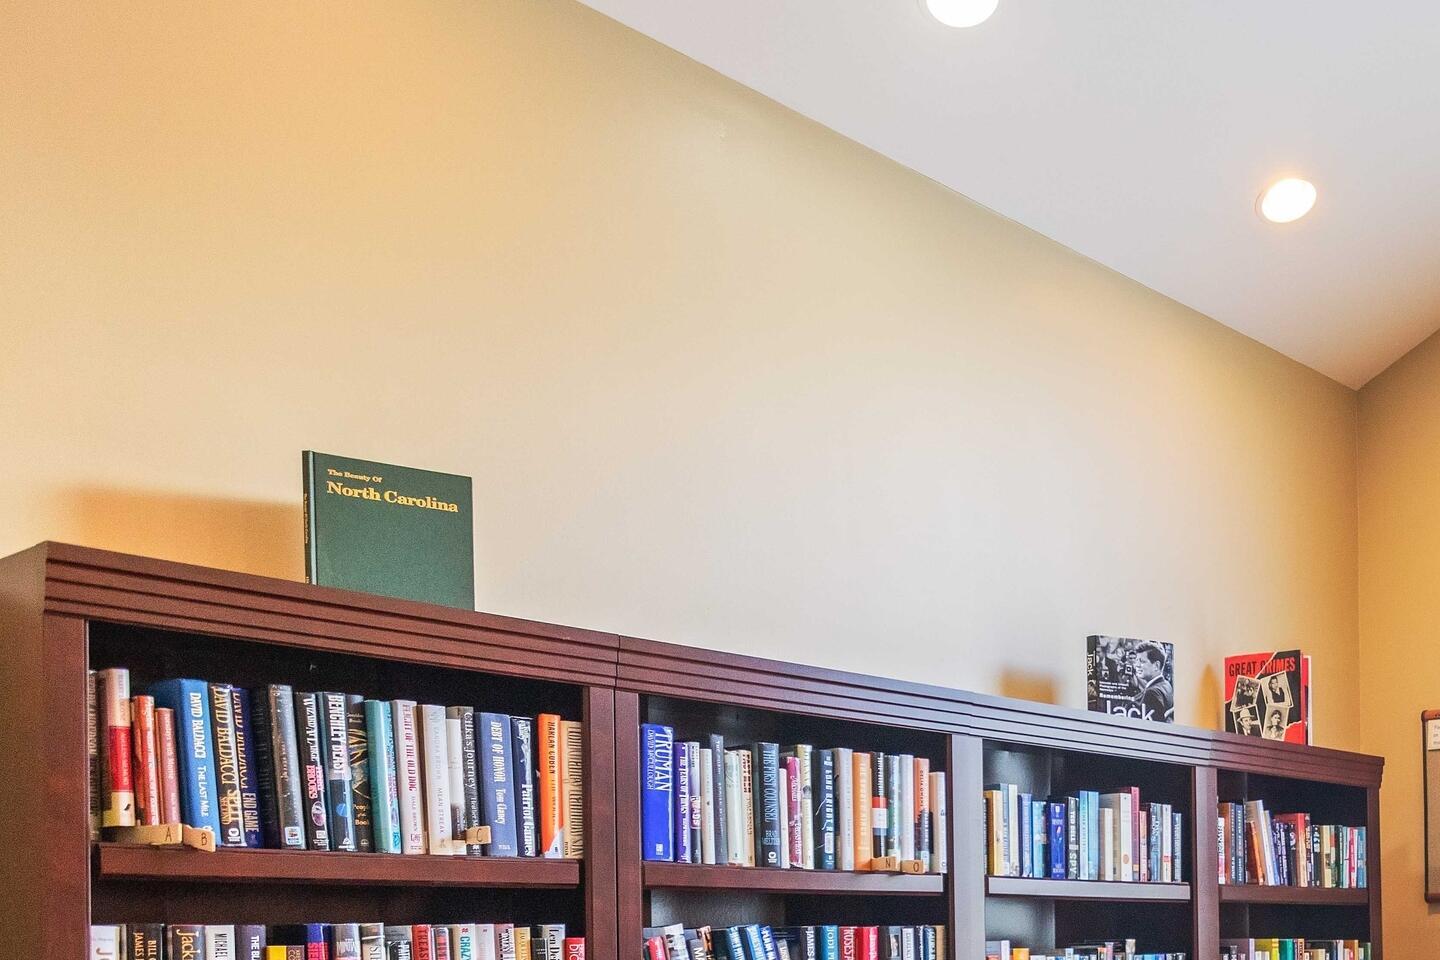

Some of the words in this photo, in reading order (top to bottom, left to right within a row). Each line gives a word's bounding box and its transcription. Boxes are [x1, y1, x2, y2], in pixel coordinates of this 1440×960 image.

[327, 481, 382, 501] North
[384, 490, 459, 513] Carolina
[1229, 661, 1257, 677] GREAT
[1260, 656, 1296, 673] CRIMES
[190, 693, 203, 718] DAVID
[191, 719, 206, 758] BALDACCI
[490, 721, 503, 741] DEBT
[492, 744, 504, 754] OF
[763, 750, 775, 765] THE
[197, 766, 207, 780] THE
[493, 756, 506, 783] HONOR
[655, 732, 673, 792] TRUMAN
[763, 766, 776, 786] FIRST
[198, 781, 208, 799] LAST
[495, 788, 506, 803] Tom
[200, 800, 210, 817] MILE
[495, 803, 508, 825] Clancy
[764, 788, 777, 823] COUNSEL
[1069, 852, 1077, 874] SPY
[135, 932, 144, 956] JAMES
[148, 940, 157, 956] BILL
[214, 933, 229, 958] MICHAEL
[251, 936, 260, 949] THE
[806, 930, 815, 955] JAMES
[843, 929, 854, 955] ROSES
